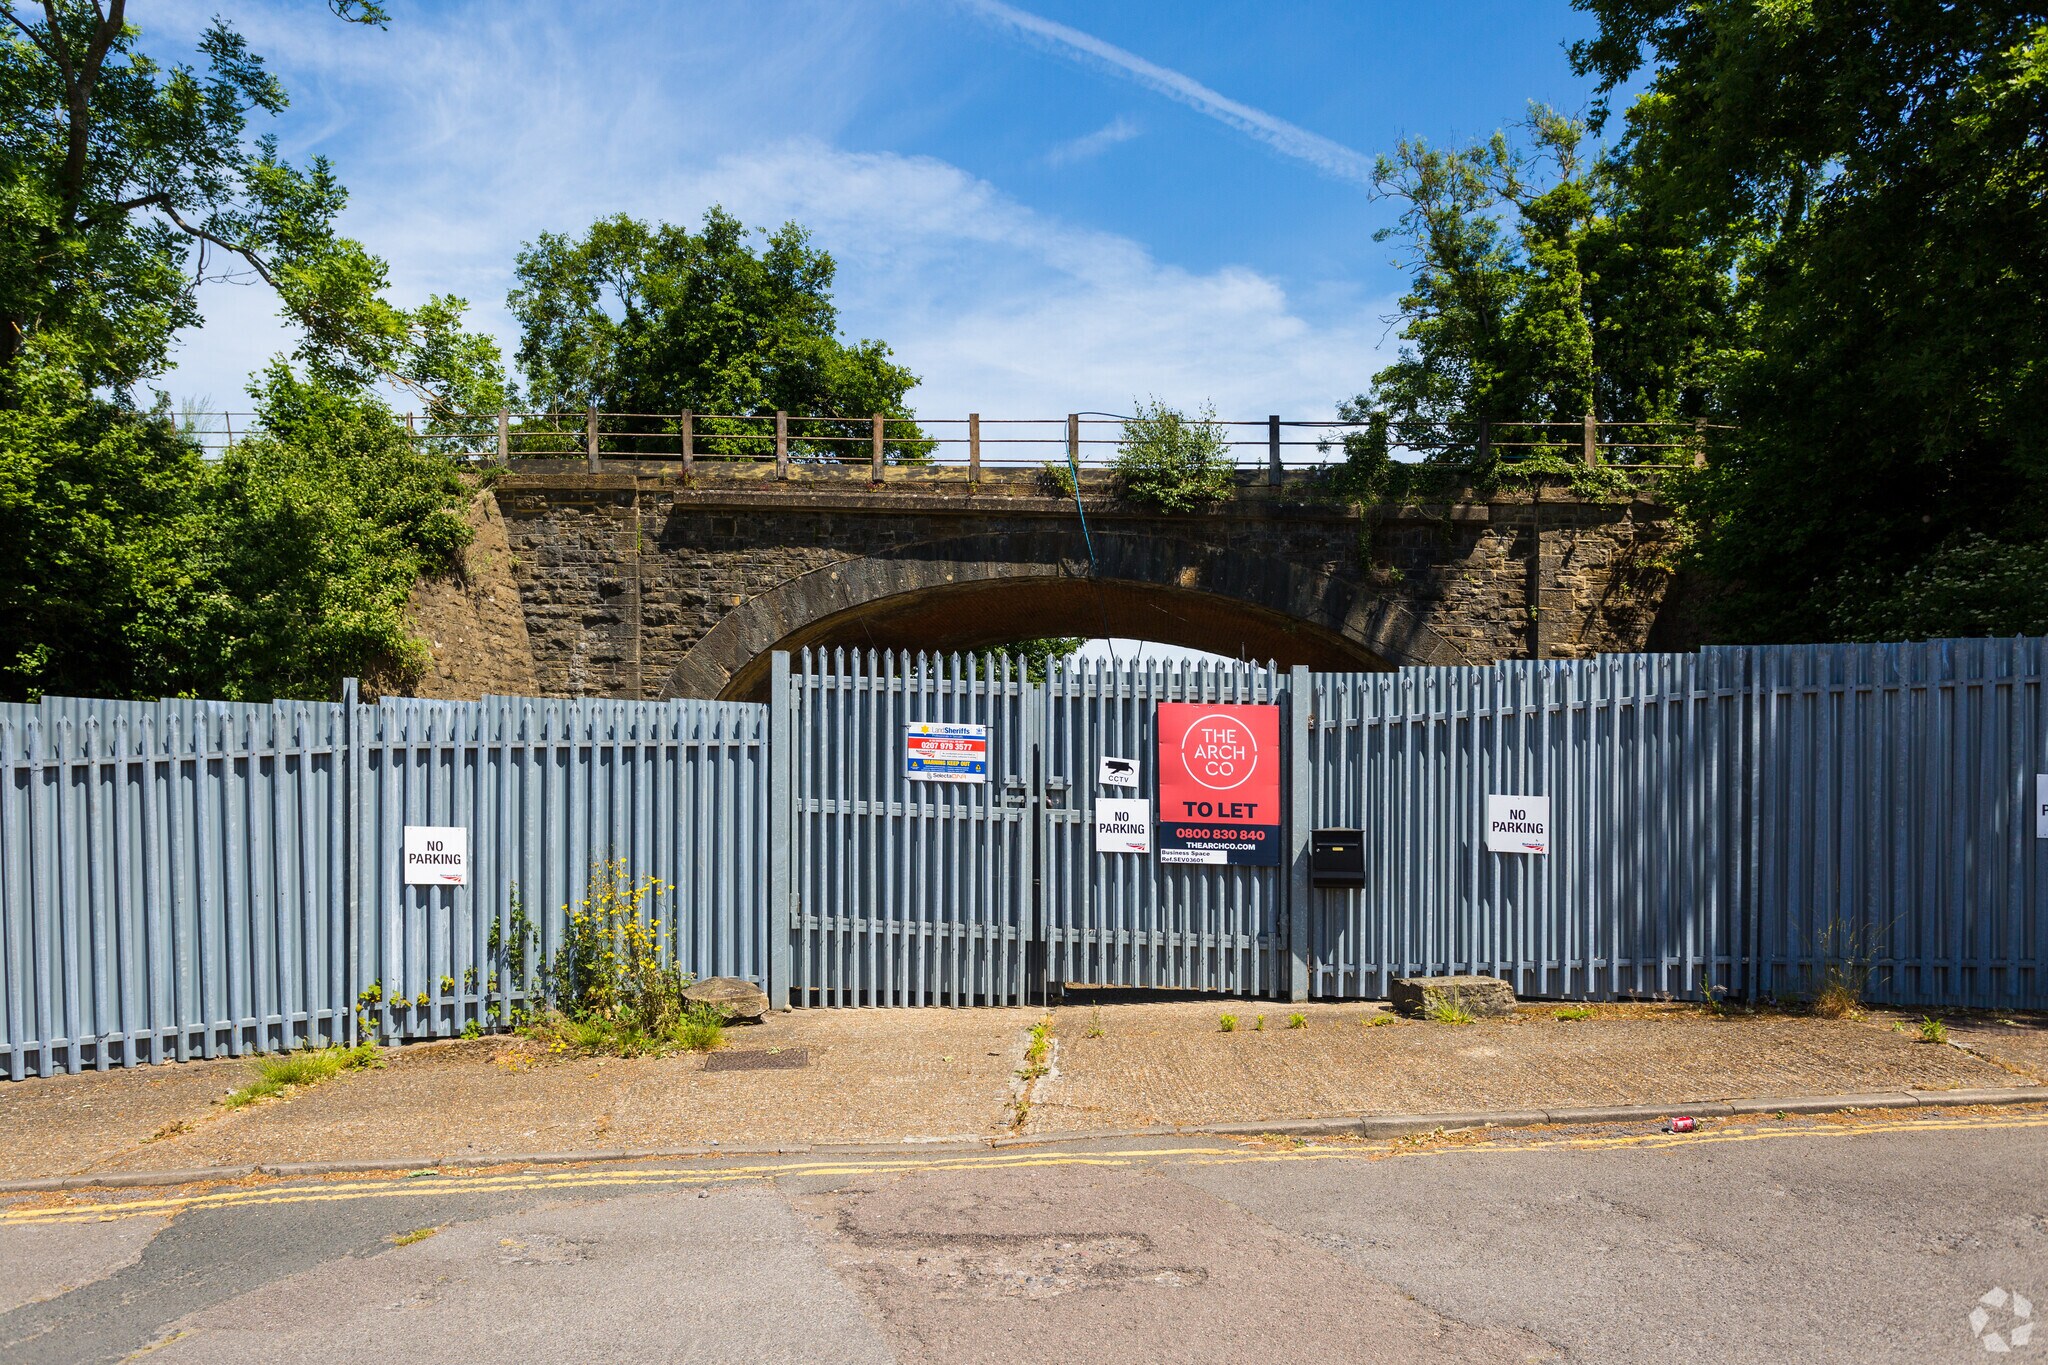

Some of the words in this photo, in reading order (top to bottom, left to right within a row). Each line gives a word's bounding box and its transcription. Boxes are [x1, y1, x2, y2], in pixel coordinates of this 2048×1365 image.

[1201, 728, 1237, 744] THE
[1194, 744, 1245, 760] ARCH
[1205, 761, 1234, 776] CO
[1108, 775, 1129, 783] CCTV
[1183, 801, 1213, 817] TO
[1218, 802, 1258, 818] LET
[1510, 809, 1526, 820] NO
[1114, 811, 1129, 821] NO
[1099, 823, 1145, 834] PARKING
[1492, 821, 1543, 834] PARKING
[1176, 828, 1210, 839] 0800
[1213, 829, 1237, 840] 830
[1240, 830, 1265, 841] 840
[427, 840, 443, 851] NO
[1186, 841, 1256, 850] THEARCHCO.COM
[409, 853, 461, 865] PARKING
